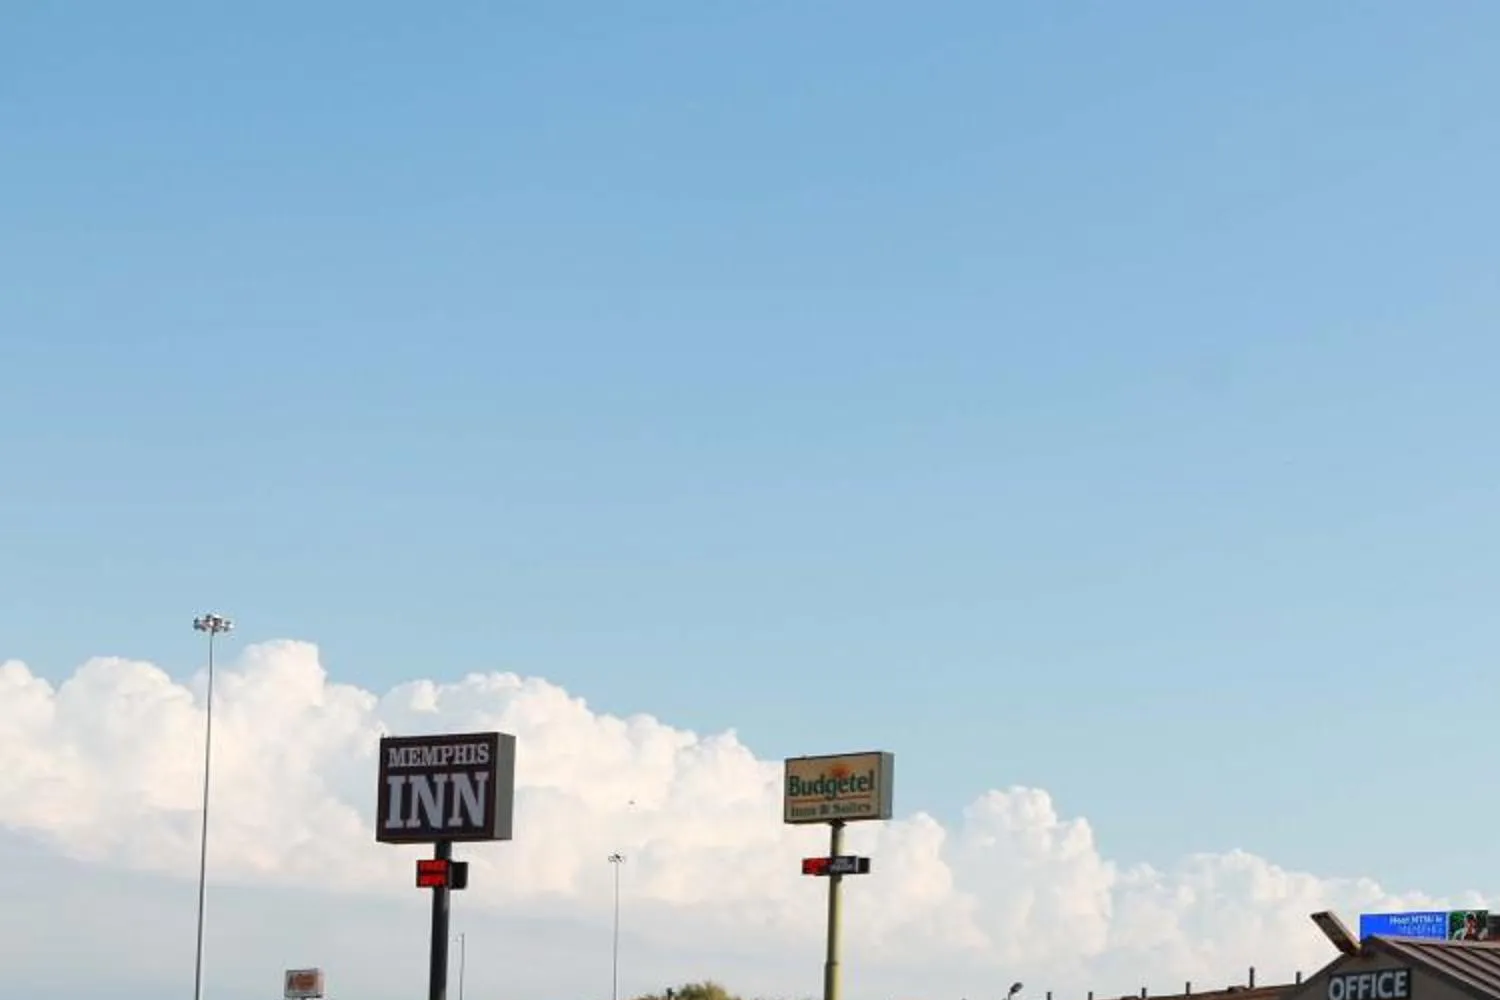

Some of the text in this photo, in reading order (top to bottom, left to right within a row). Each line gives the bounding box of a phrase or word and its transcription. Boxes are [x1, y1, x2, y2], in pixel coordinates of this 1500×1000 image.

[388, 743, 489, 767] MEMPHIS
[788, 769, 875, 799] Budgetel
[385, 771, 489, 829] INN
